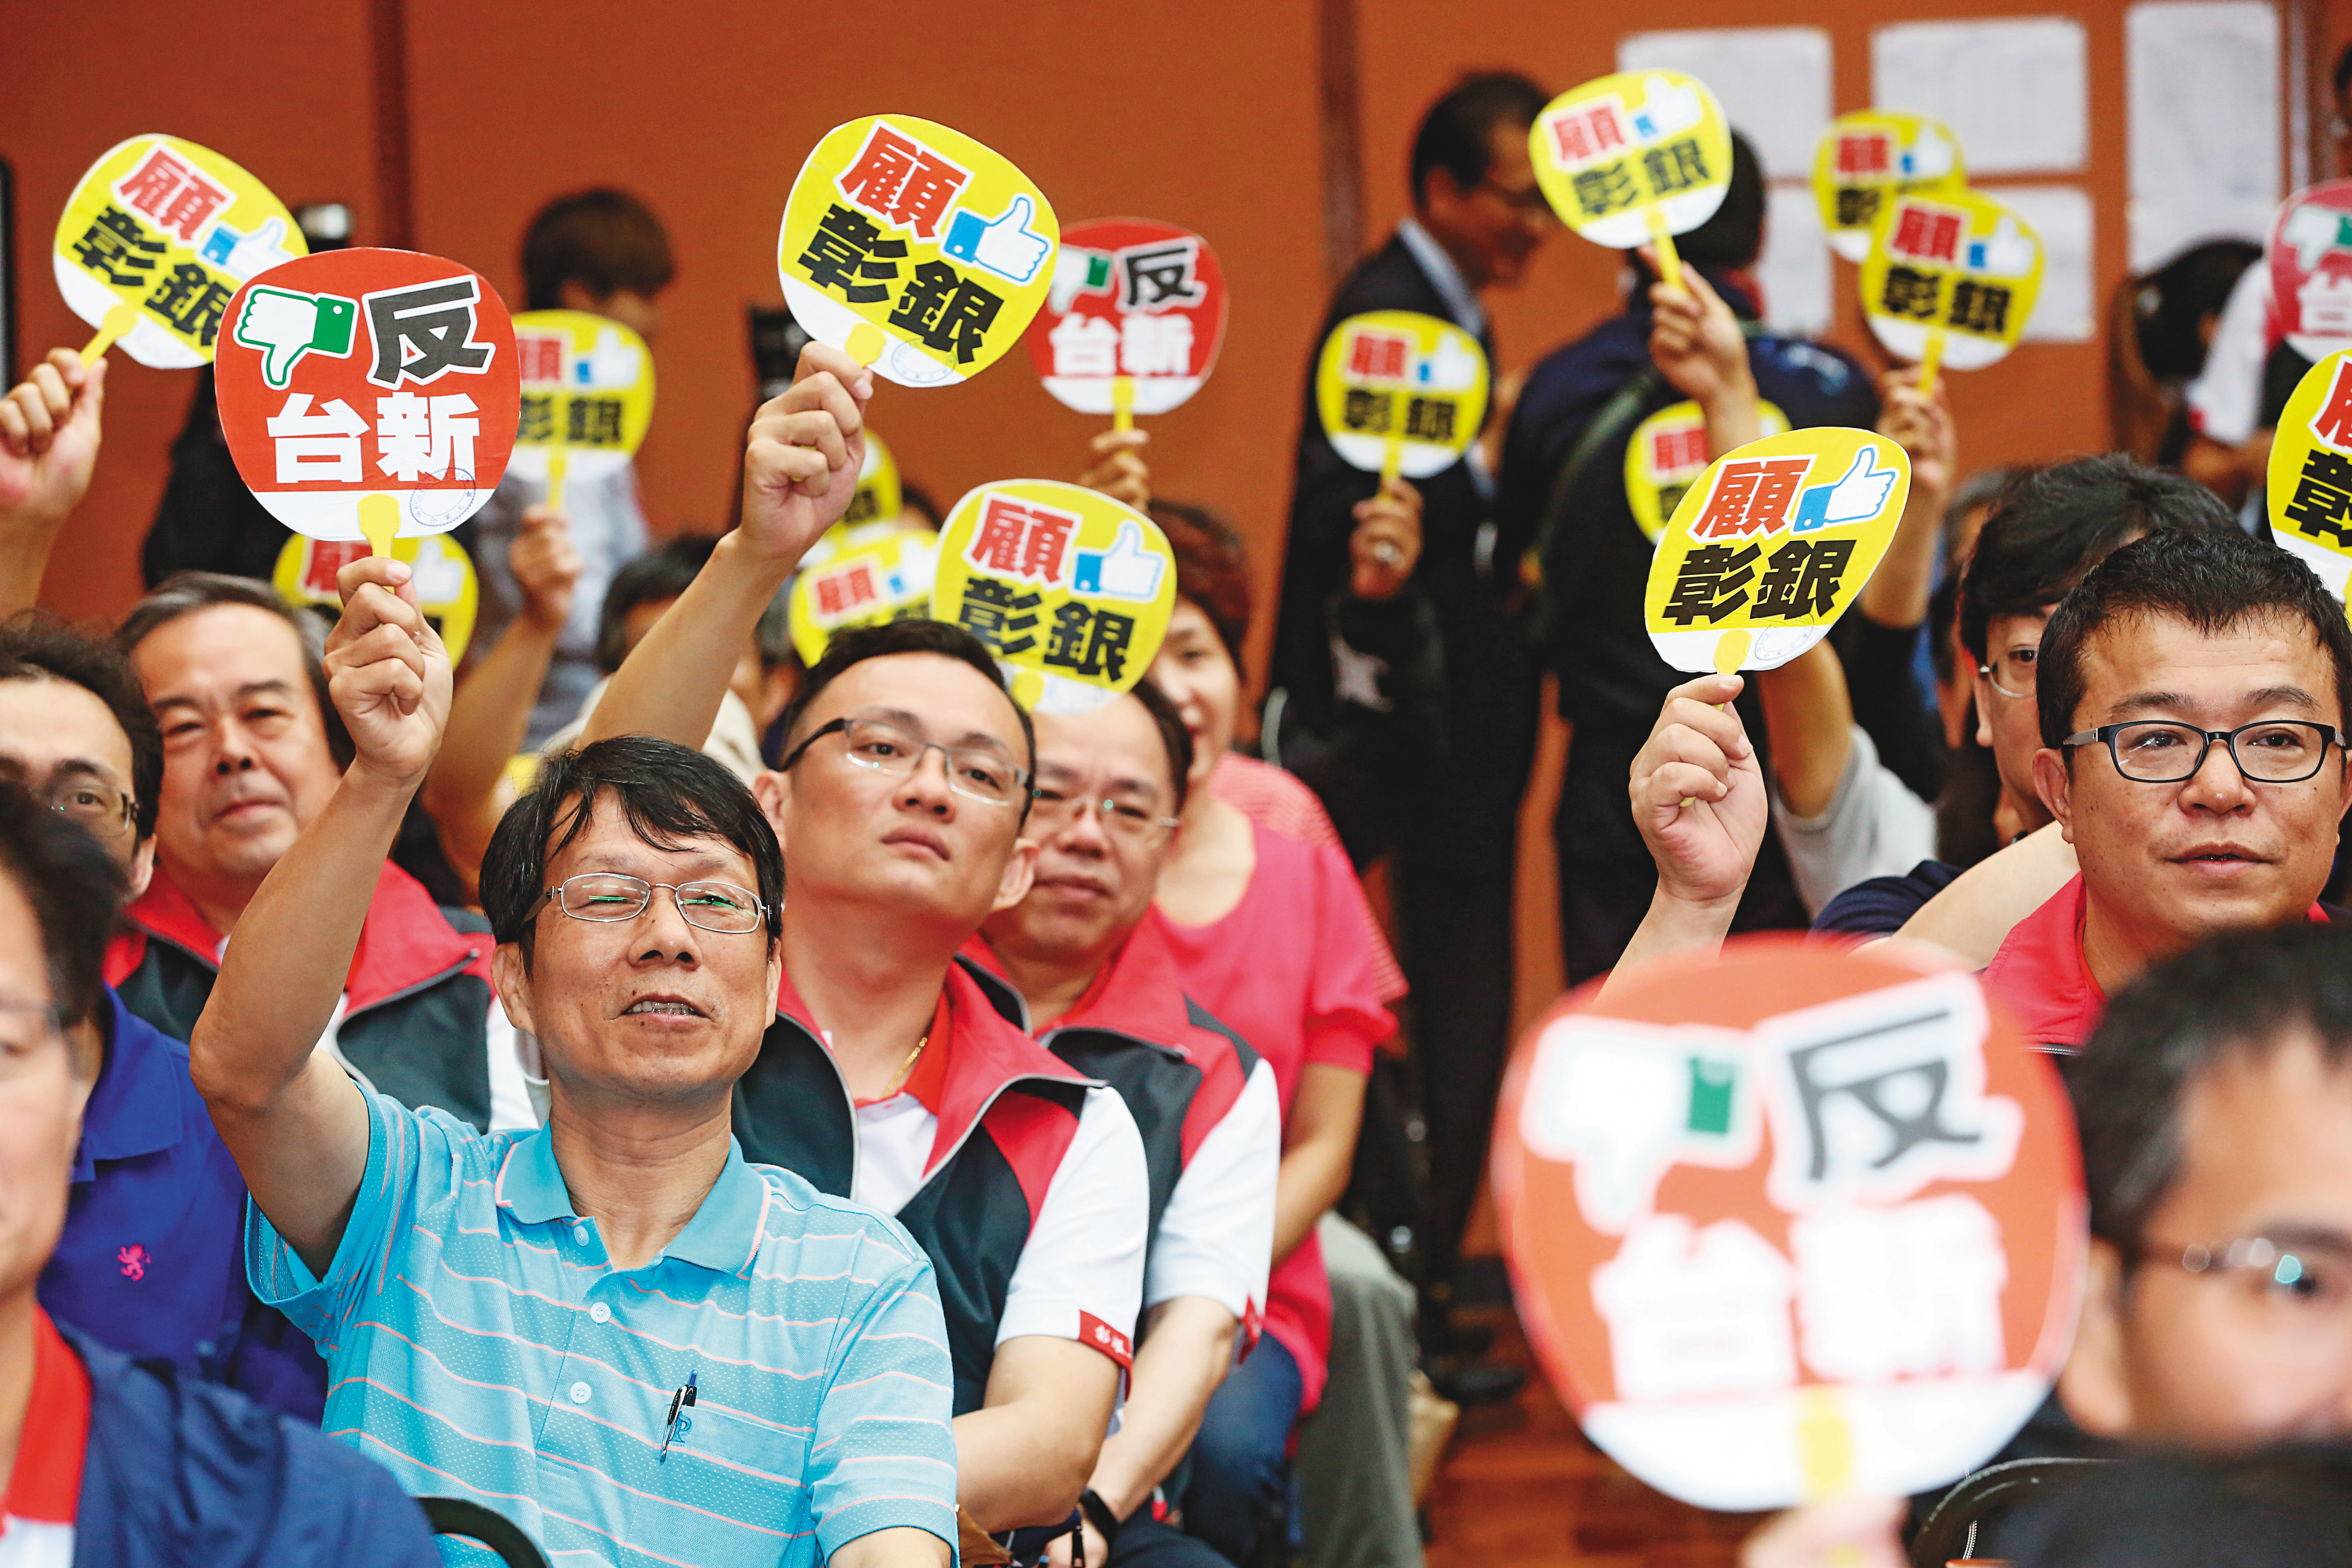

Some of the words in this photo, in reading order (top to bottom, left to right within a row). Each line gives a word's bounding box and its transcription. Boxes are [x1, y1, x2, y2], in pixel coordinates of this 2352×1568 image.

[118, 145, 229, 242] 顧
[840, 126, 968, 238] 顧
[72, 205, 232, 346] 彰銀
[797, 203, 1004, 364] 彰銀
[1125, 246, 1196, 307] 反
[368, 280, 494, 385] 反
[265, 391, 481, 483] 台新
[971, 497, 1075, 584] 顧
[1693, 458, 1812, 539] 顧
[958, 577, 1134, 683] 彰銀
[1662, 539, 1858, 627] 彰銀
[1781, 1002, 1993, 1188] 反
